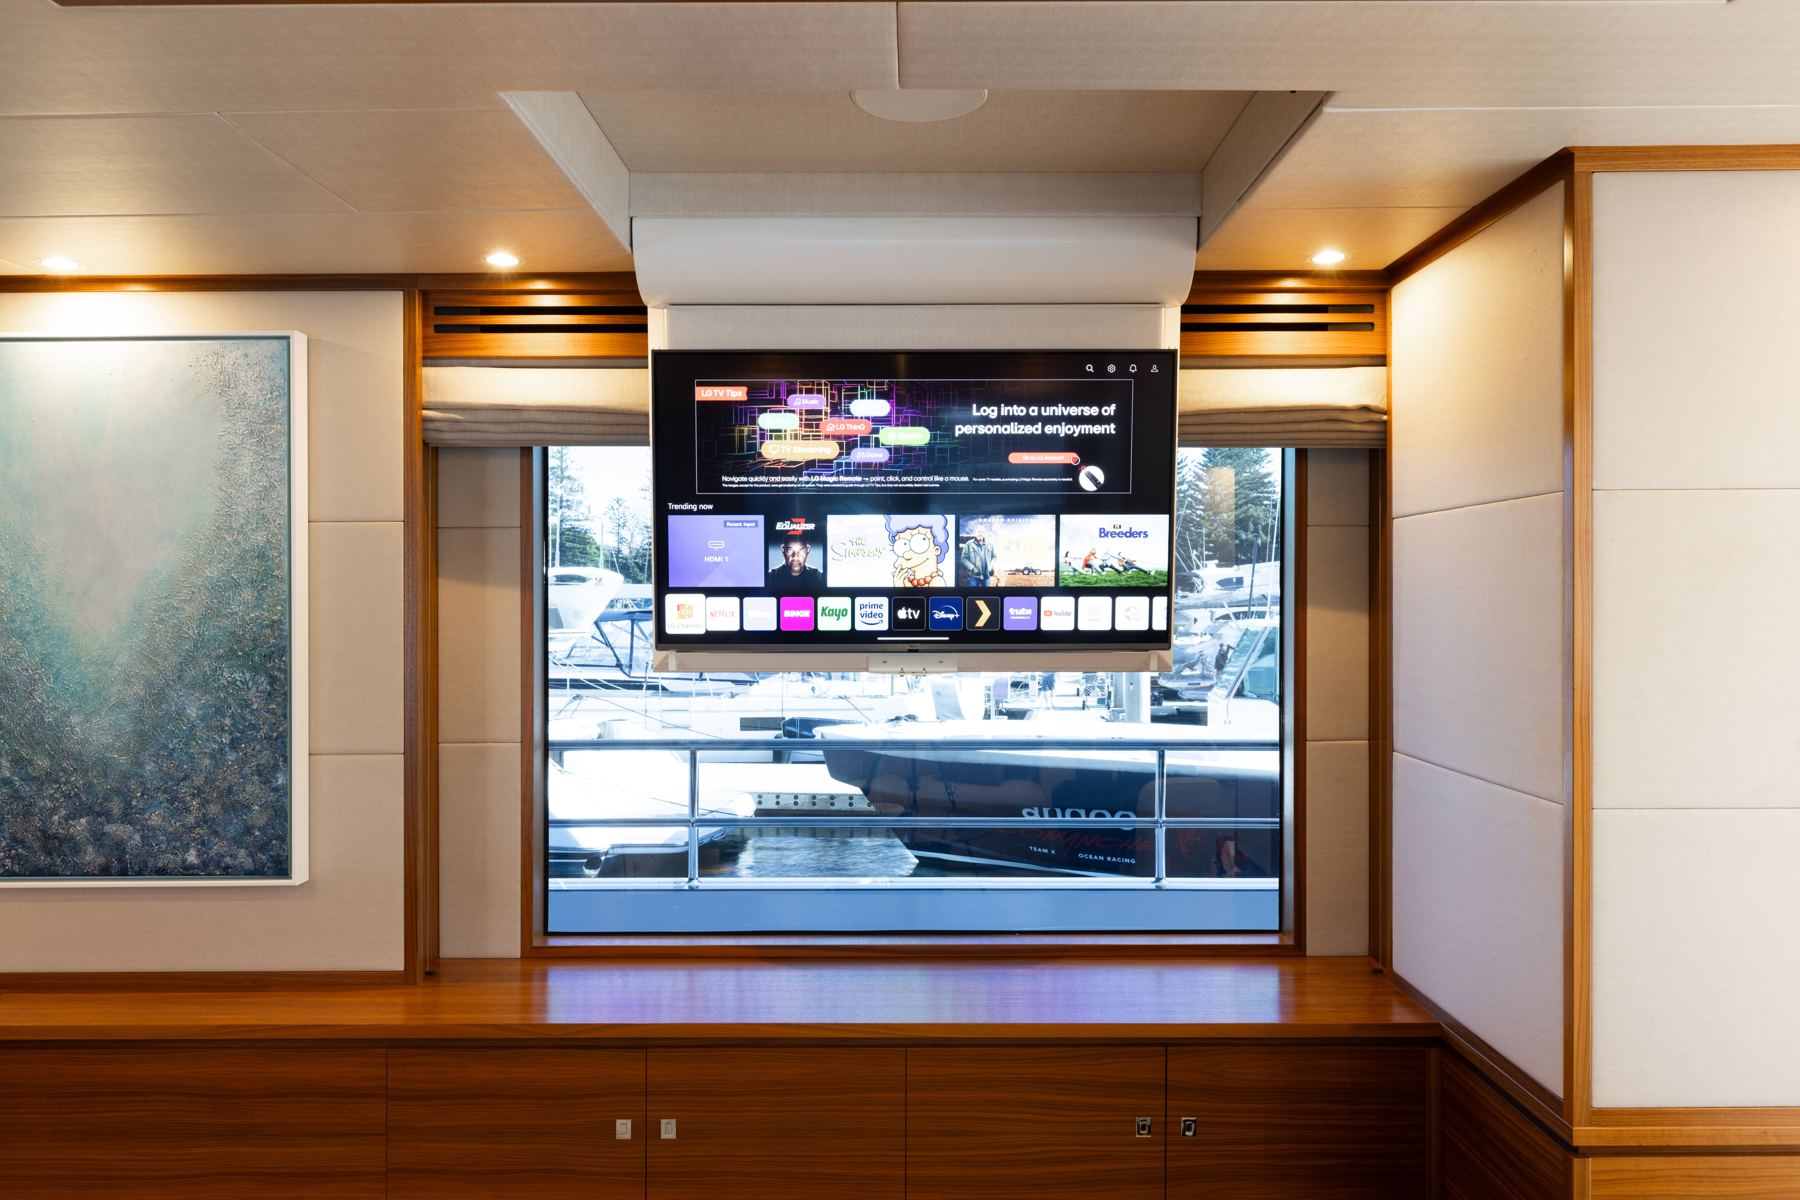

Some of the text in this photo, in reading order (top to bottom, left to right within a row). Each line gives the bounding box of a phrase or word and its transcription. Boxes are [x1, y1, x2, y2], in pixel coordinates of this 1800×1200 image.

[701, 389, 743, 398] LG TV Tips
[972, 403, 1116, 419] Log into a universe of
[954, 422, 1116, 437] personalized enjoyment
[722, 475, 748, 483] Navigate
[749, 475, 768, 483] quickly
[667, 502, 698, 511] Trending
[1098, 526, 1149, 538] Breeders
[859, 601, 884, 611] prime
[709, 609, 736, 618] NETFLIX
[820, 606, 849, 621] Kayo
[859, 611, 884, 619] video
[908, 607, 920, 619] tv
[1029, 846, 1048, 854] TEAM
[1078, 853, 1104, 861] OCEAN
[1106, 856, 1136, 864] RACING
